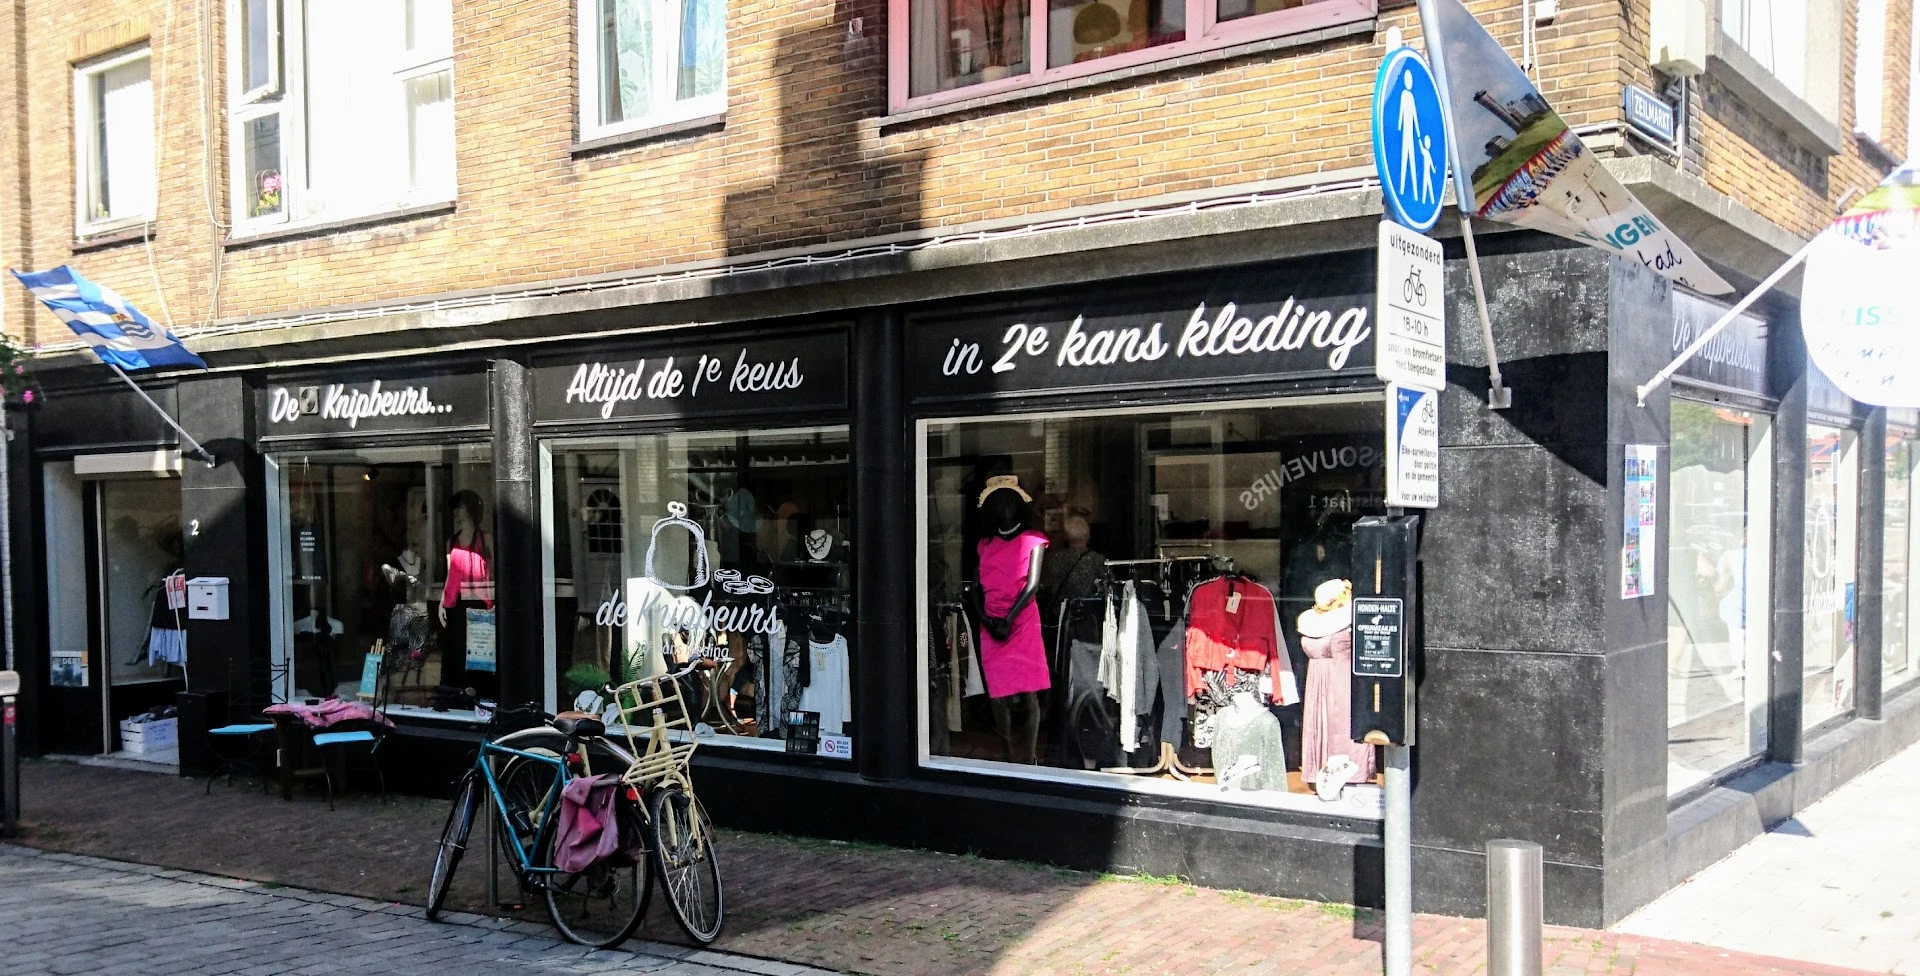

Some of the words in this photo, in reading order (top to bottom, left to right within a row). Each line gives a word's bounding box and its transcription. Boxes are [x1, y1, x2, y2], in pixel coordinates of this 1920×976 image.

[1634, 94, 1671, 133] ZEILMARKT
[1390, 233, 1441, 265] uitgezonderd
[942, 337, 984, 376] in
[991, 322, 1049, 373] 2e
[1056, 313, 1168, 368] kans
[1176, 294, 1371, 371] kleding
[1403, 315, 1422, 335] 18-10
[1424, 321, 1429, 337] h
[1407, 360, 1437, 376] toegestaan
[1412, 346, 1443, 364] bromfietsen
[566, 358, 645, 420] Altijd
[648, 356, 684, 399] de
[691, 353, 722, 397] 1e
[729, 347, 803, 392] keus
[271, 387, 300, 423] De
[322, 378, 453, 429] Knipbeurs...
[190, 519, 200, 536] 2
[596, 588, 629, 627] de
[636, 589, 782, 635] Knipbeurs
